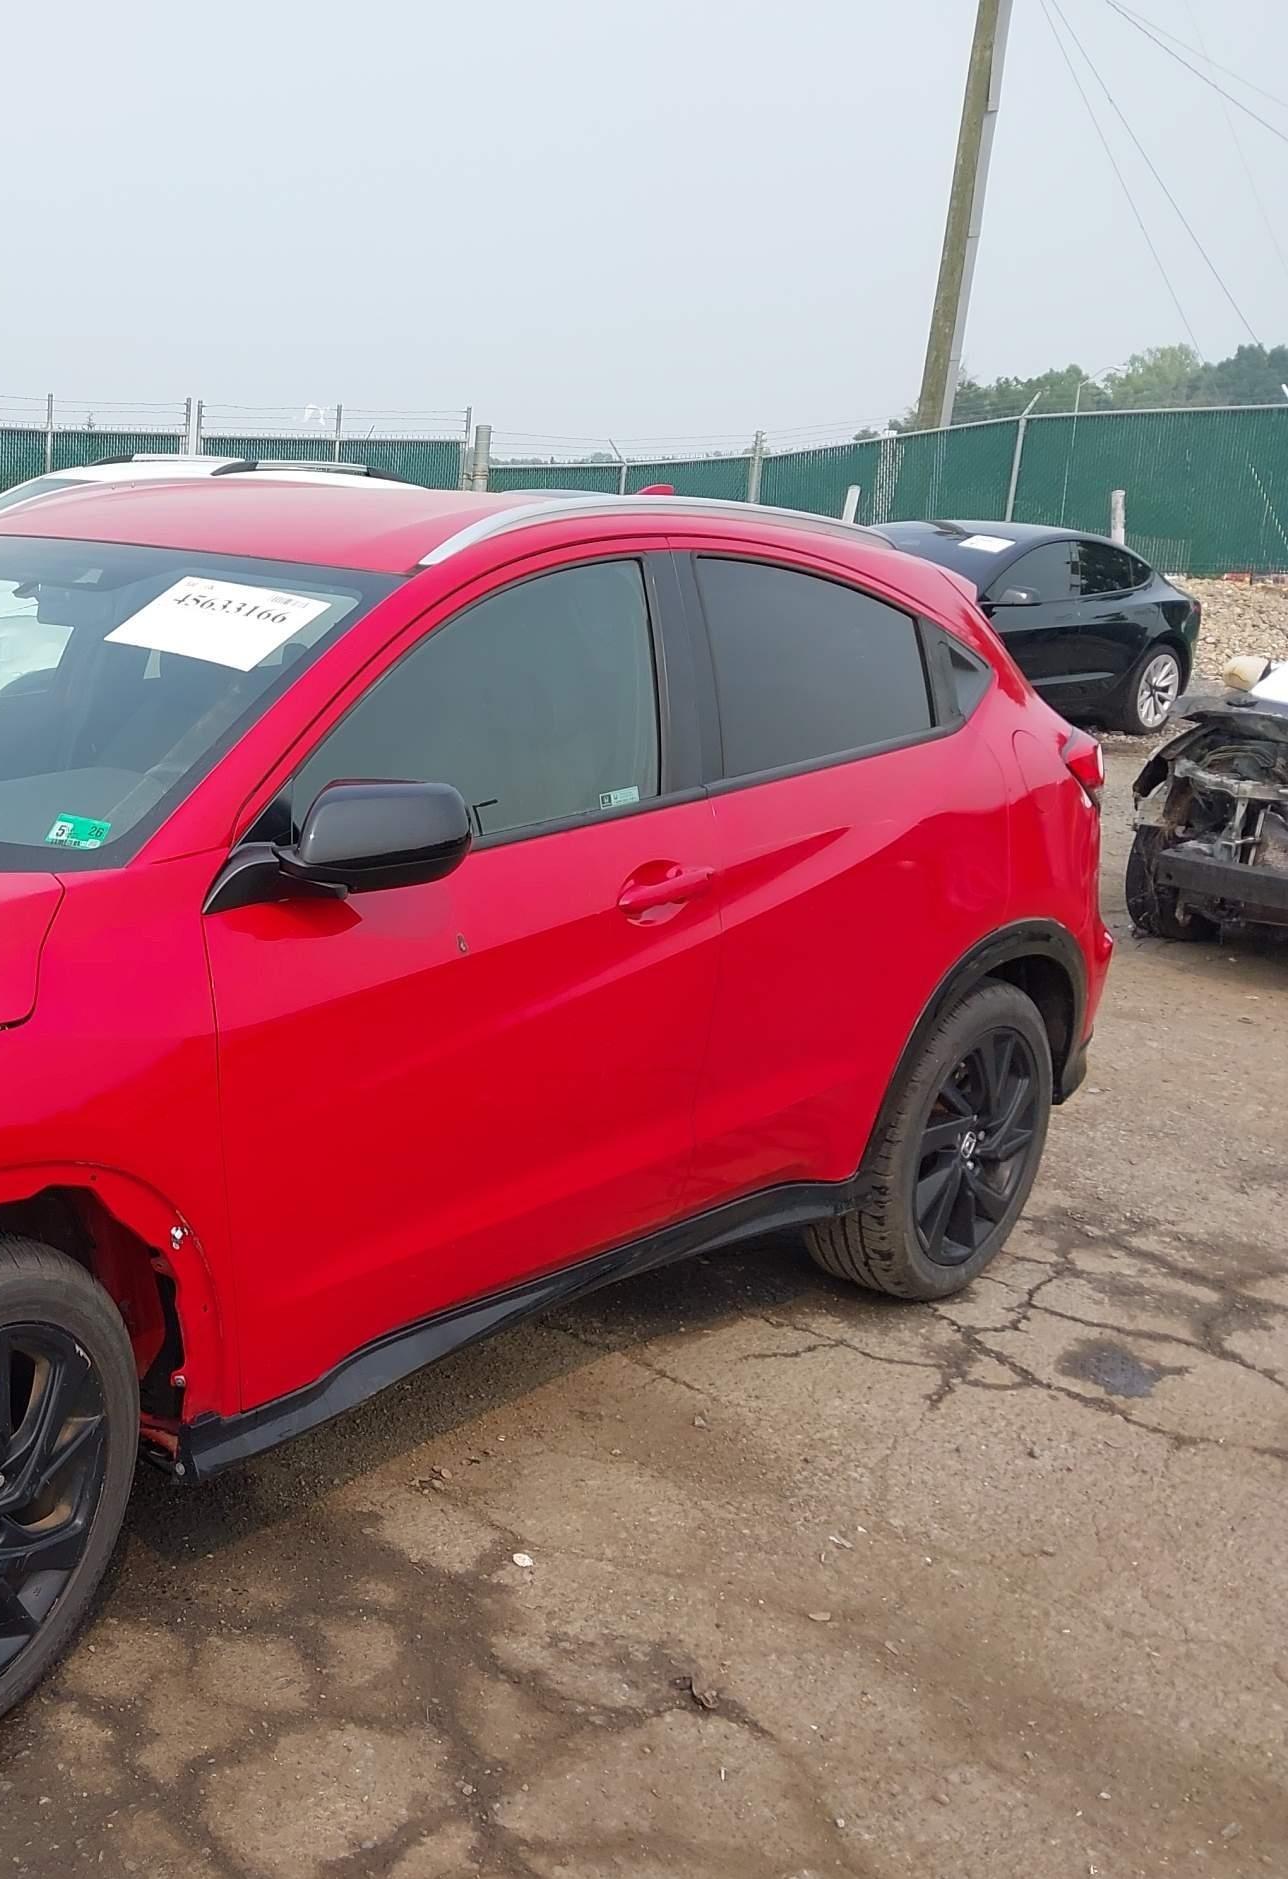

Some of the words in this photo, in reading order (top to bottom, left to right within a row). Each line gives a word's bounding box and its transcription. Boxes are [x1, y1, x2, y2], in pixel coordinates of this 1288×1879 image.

[172, 593, 288, 624] 45633166
[55, 824, 67, 837] 5
[88, 825, 105, 838] 26
